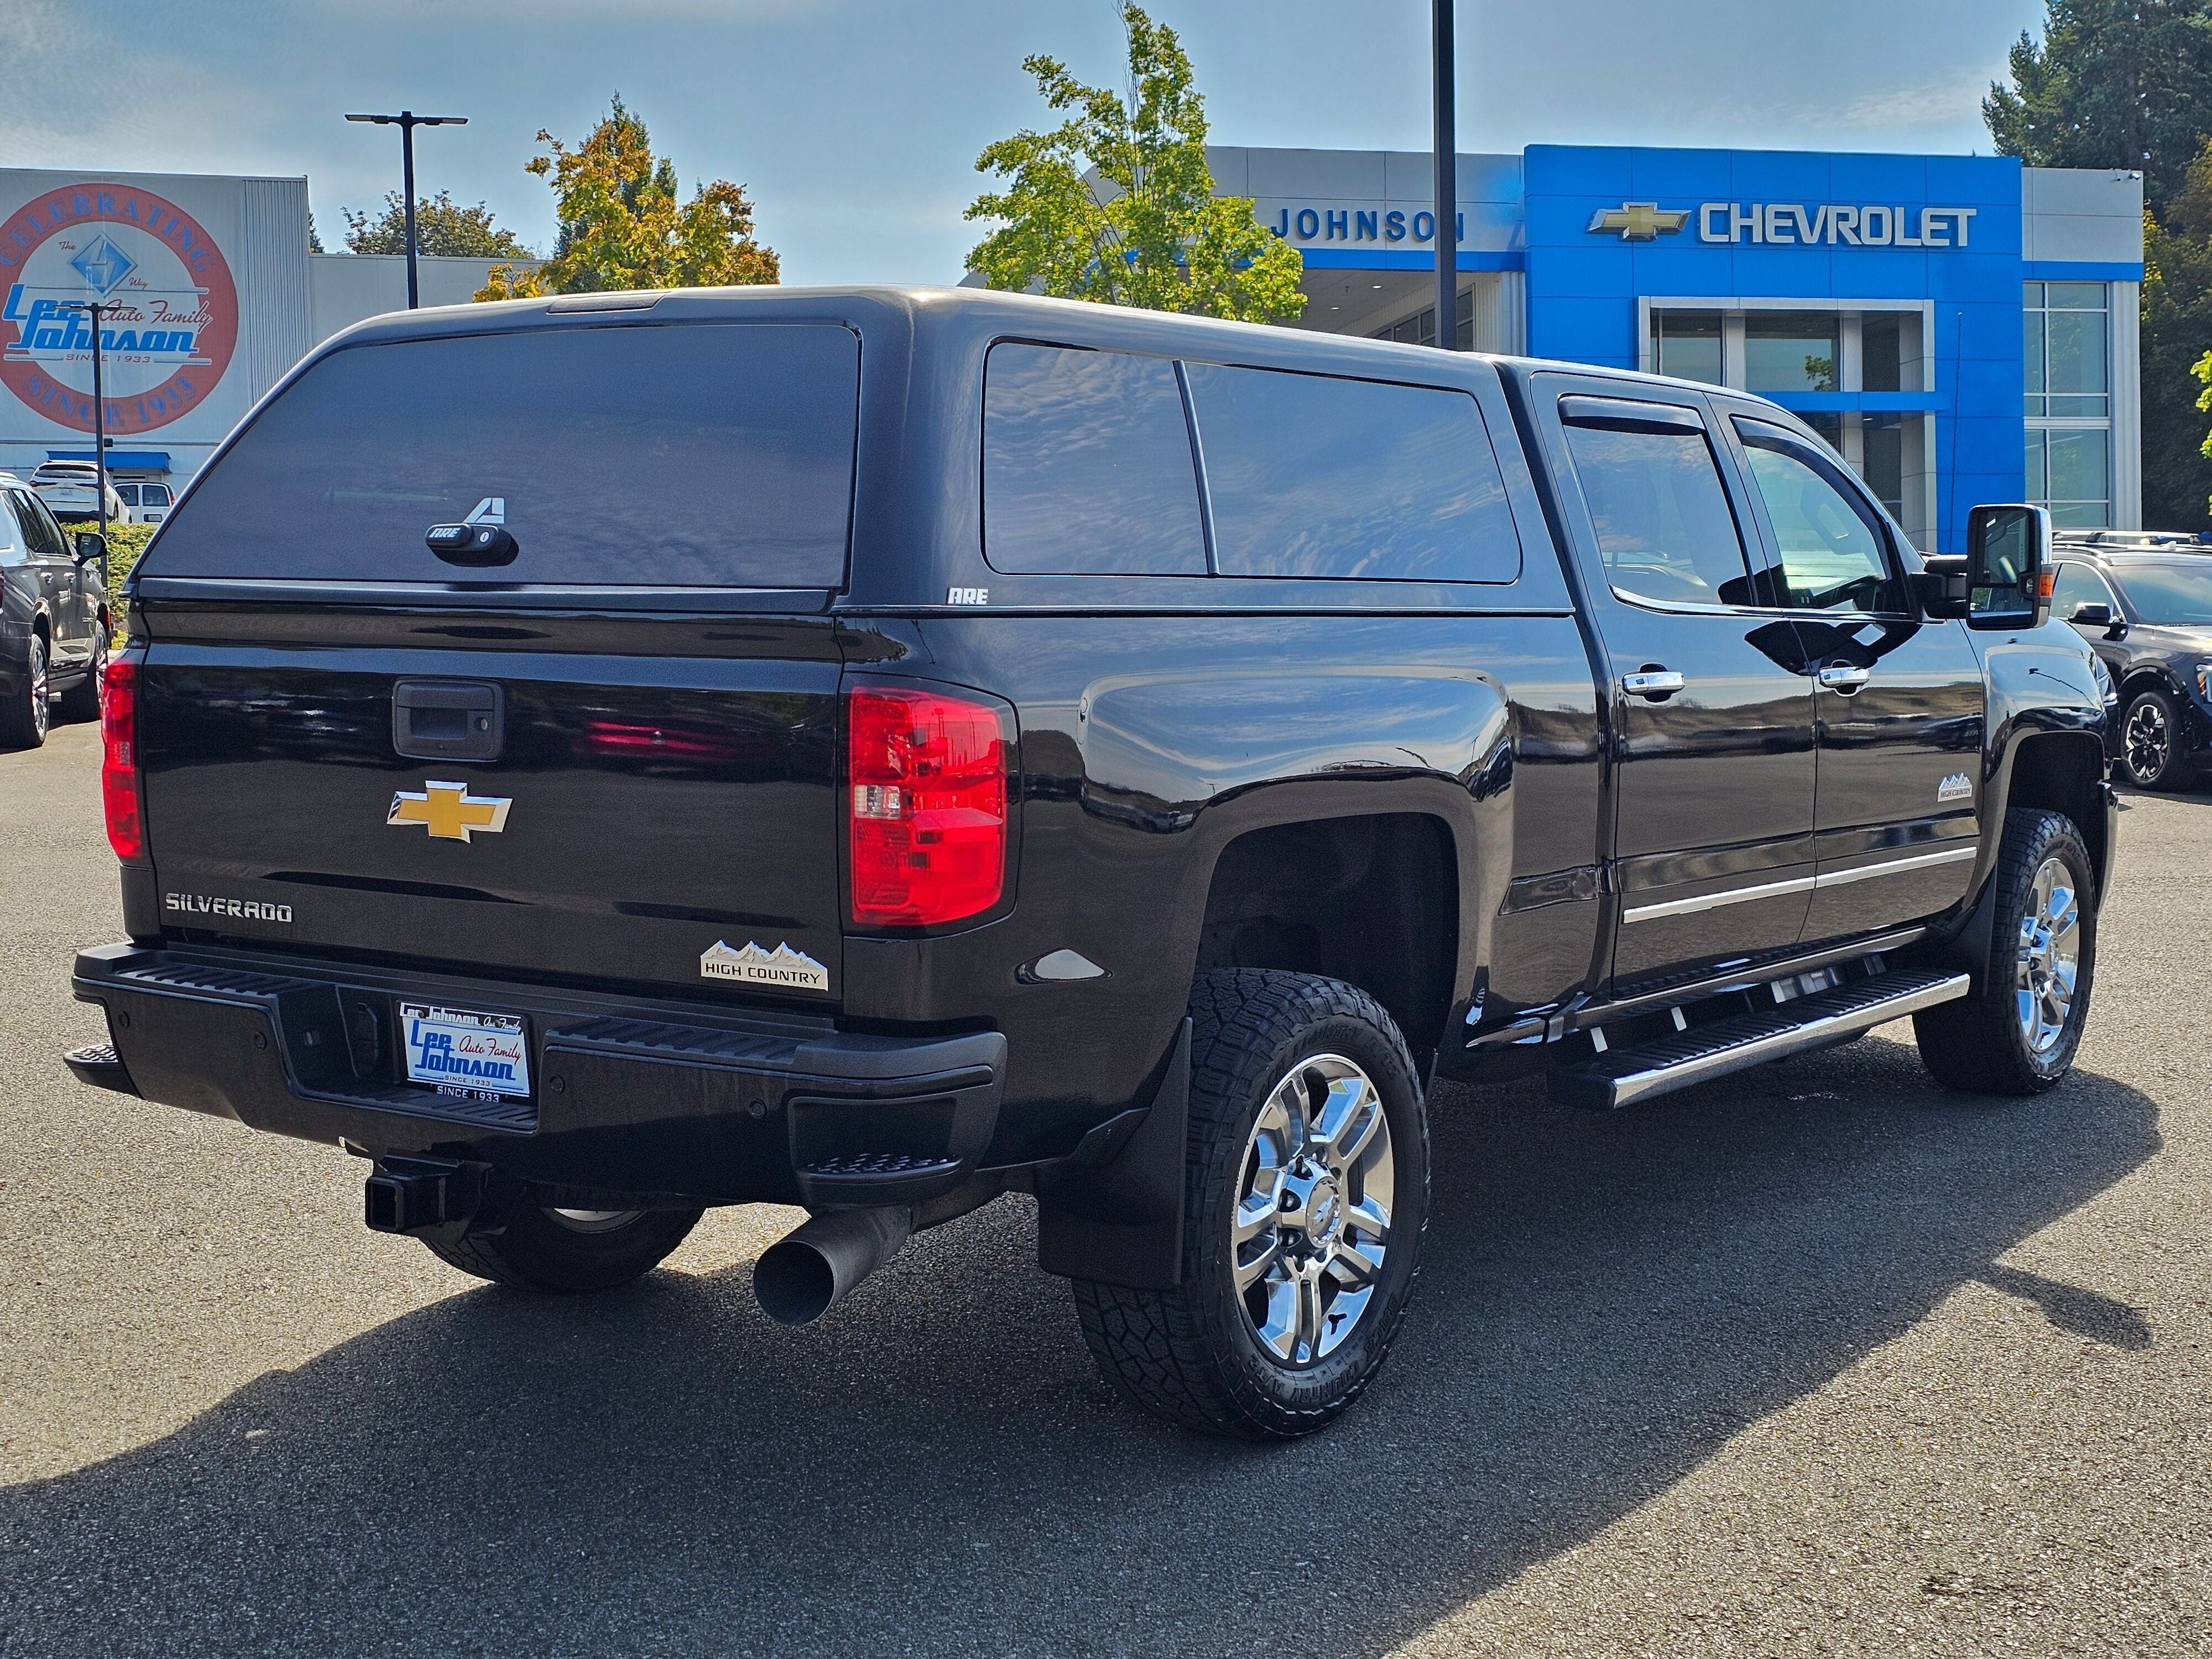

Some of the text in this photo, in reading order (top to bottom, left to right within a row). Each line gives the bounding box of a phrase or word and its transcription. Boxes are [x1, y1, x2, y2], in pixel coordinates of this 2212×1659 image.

[0, 192, 215, 272] CELEBRATING
[1700, 203, 1977, 247] CHEVROLET
[59, 241, 76, 250] The
[129, 277, 148, 289] Way
[2, 283, 89, 321] Lee
[100, 299, 213, 334] Auto Family
[7, 316, 200, 353] Johnson
[24, 374, 196, 427] SINCE 1933
[429, 528, 461, 538] ARE
[948, 587, 988, 604] ARE
[166, 893, 292, 922] SILVERADO
[706, 963, 821, 984] HIGH COUNTRY
[426, 1006, 481, 1026] Johnson
[483, 1016, 497, 1028] Au
[411, 1020, 455, 1051] Lee
[459, 1035, 521, 1066] Auto Family
[415, 1045, 516, 1081] Johnson
[436, 1086, 499, 1103] SINCE 1933
